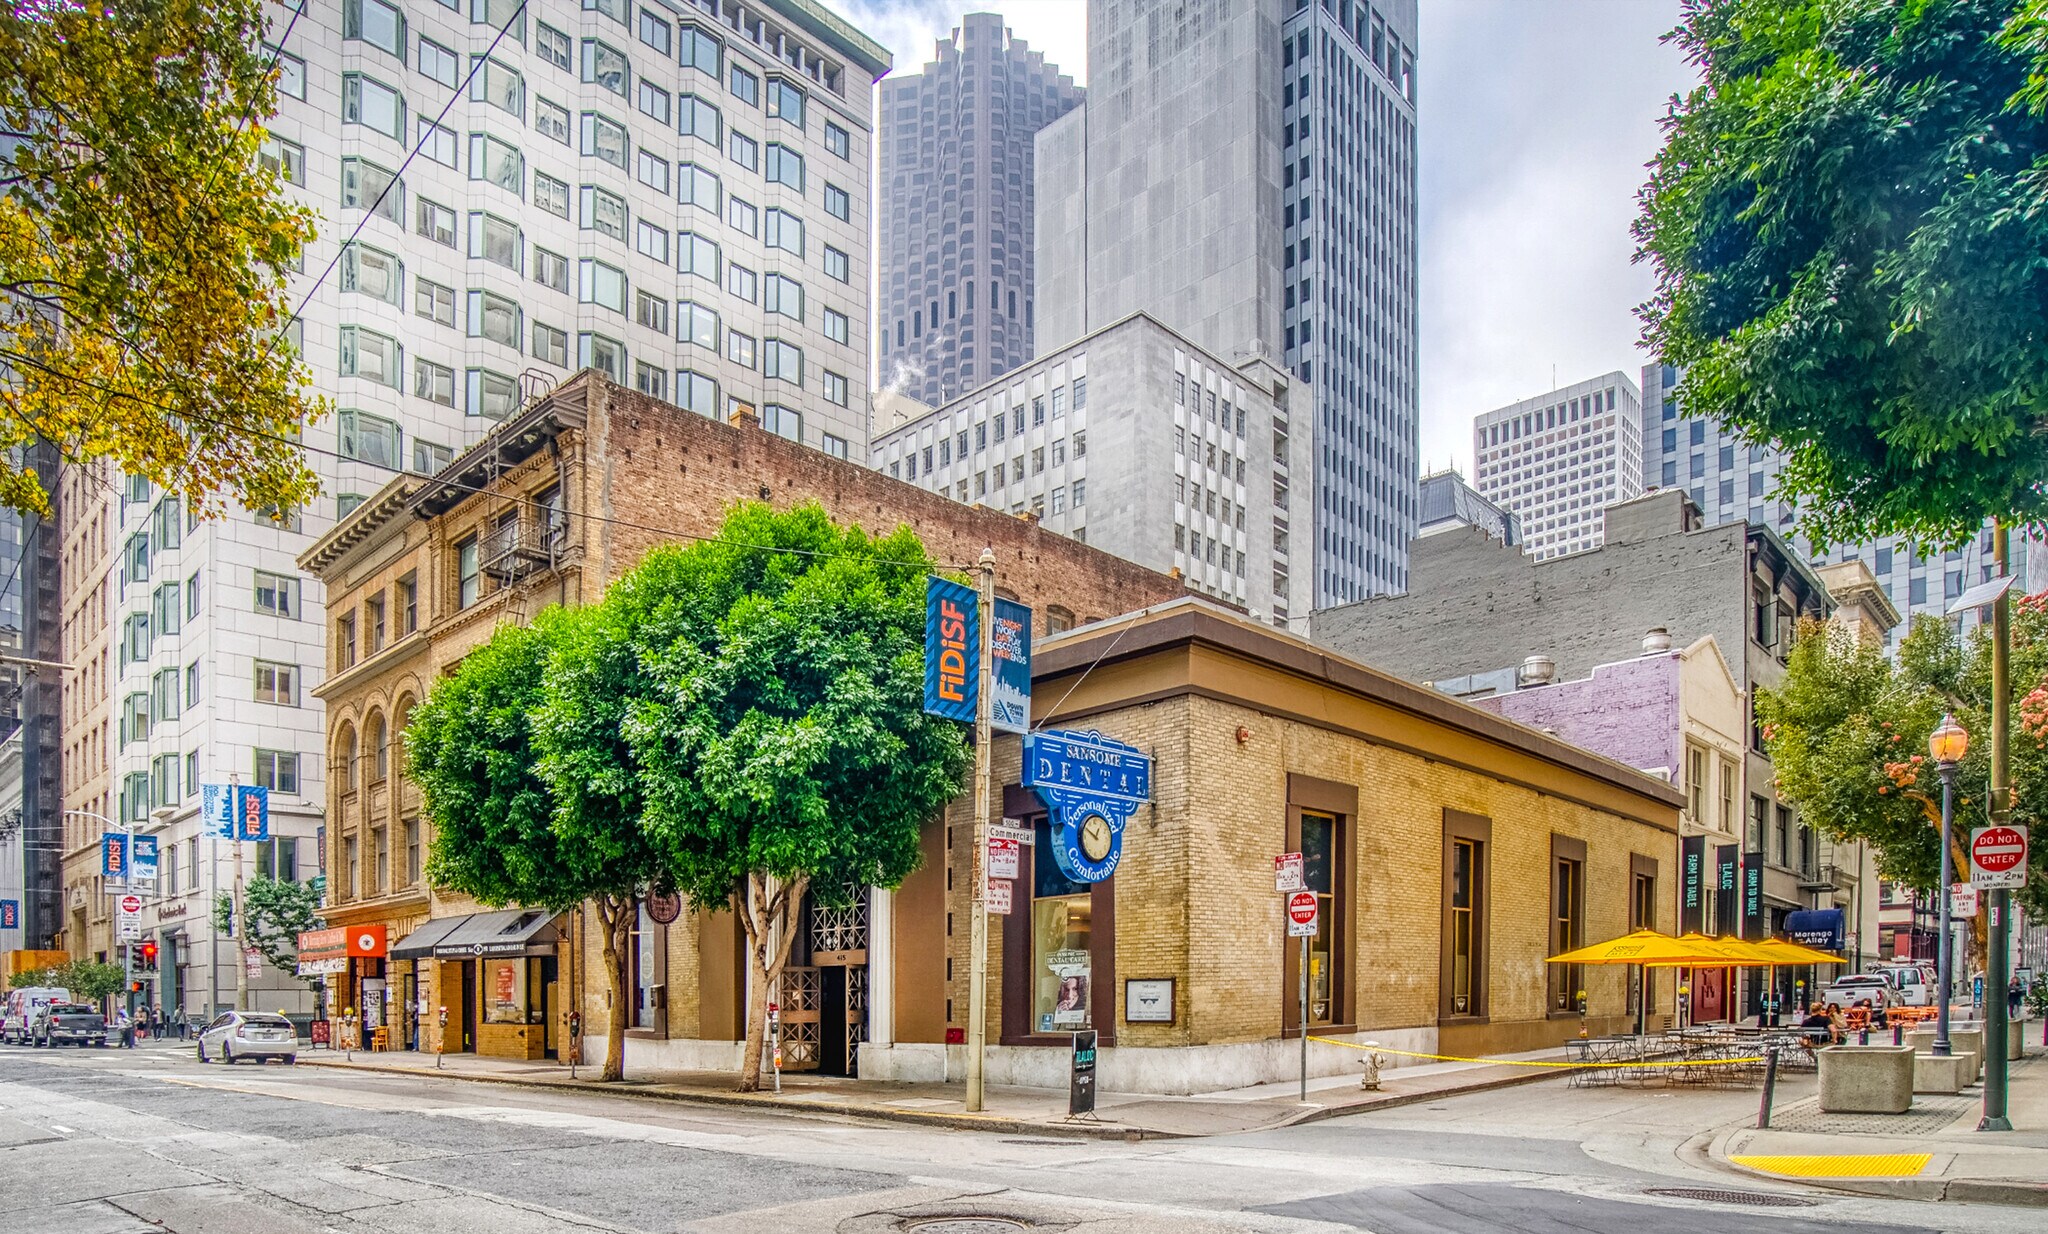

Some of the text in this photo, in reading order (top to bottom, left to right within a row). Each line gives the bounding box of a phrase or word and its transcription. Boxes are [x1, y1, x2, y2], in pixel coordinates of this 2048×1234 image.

[939, 599, 966, 702] FiDiSF
[1066, 744, 1121, 768] SANSOME
[1039, 757, 1148, 796] DENTAL
[246, 793, 261, 835] FiDiSF
[1067, 800, 1120, 834] Personalized
[990, 827, 1033, 842] Commercial
[1980, 834, 2018, 845] DO NOT
[108, 839, 121, 872] FiDiSF
[1068, 847, 1120, 881] Comfortable
[1982, 855, 2015, 864] ENTER
[1687, 854, 1698, 908] FARM TO TABLE
[1722, 861, 1733, 890] TLALOC
[1972, 872, 1993, 882] 11AM
[2004, 871, 2024, 881] 2PM
[1747, 869, 1758, 916] FARM TO TABLE
[1952, 884, 1963, 894] NO
[1952, 893, 1975, 901] PARKING
[1294, 911, 1312, 919] ENTER
[1794, 930, 1833, 938] Marengo
[1805, 937, 1829, 945] Alley
